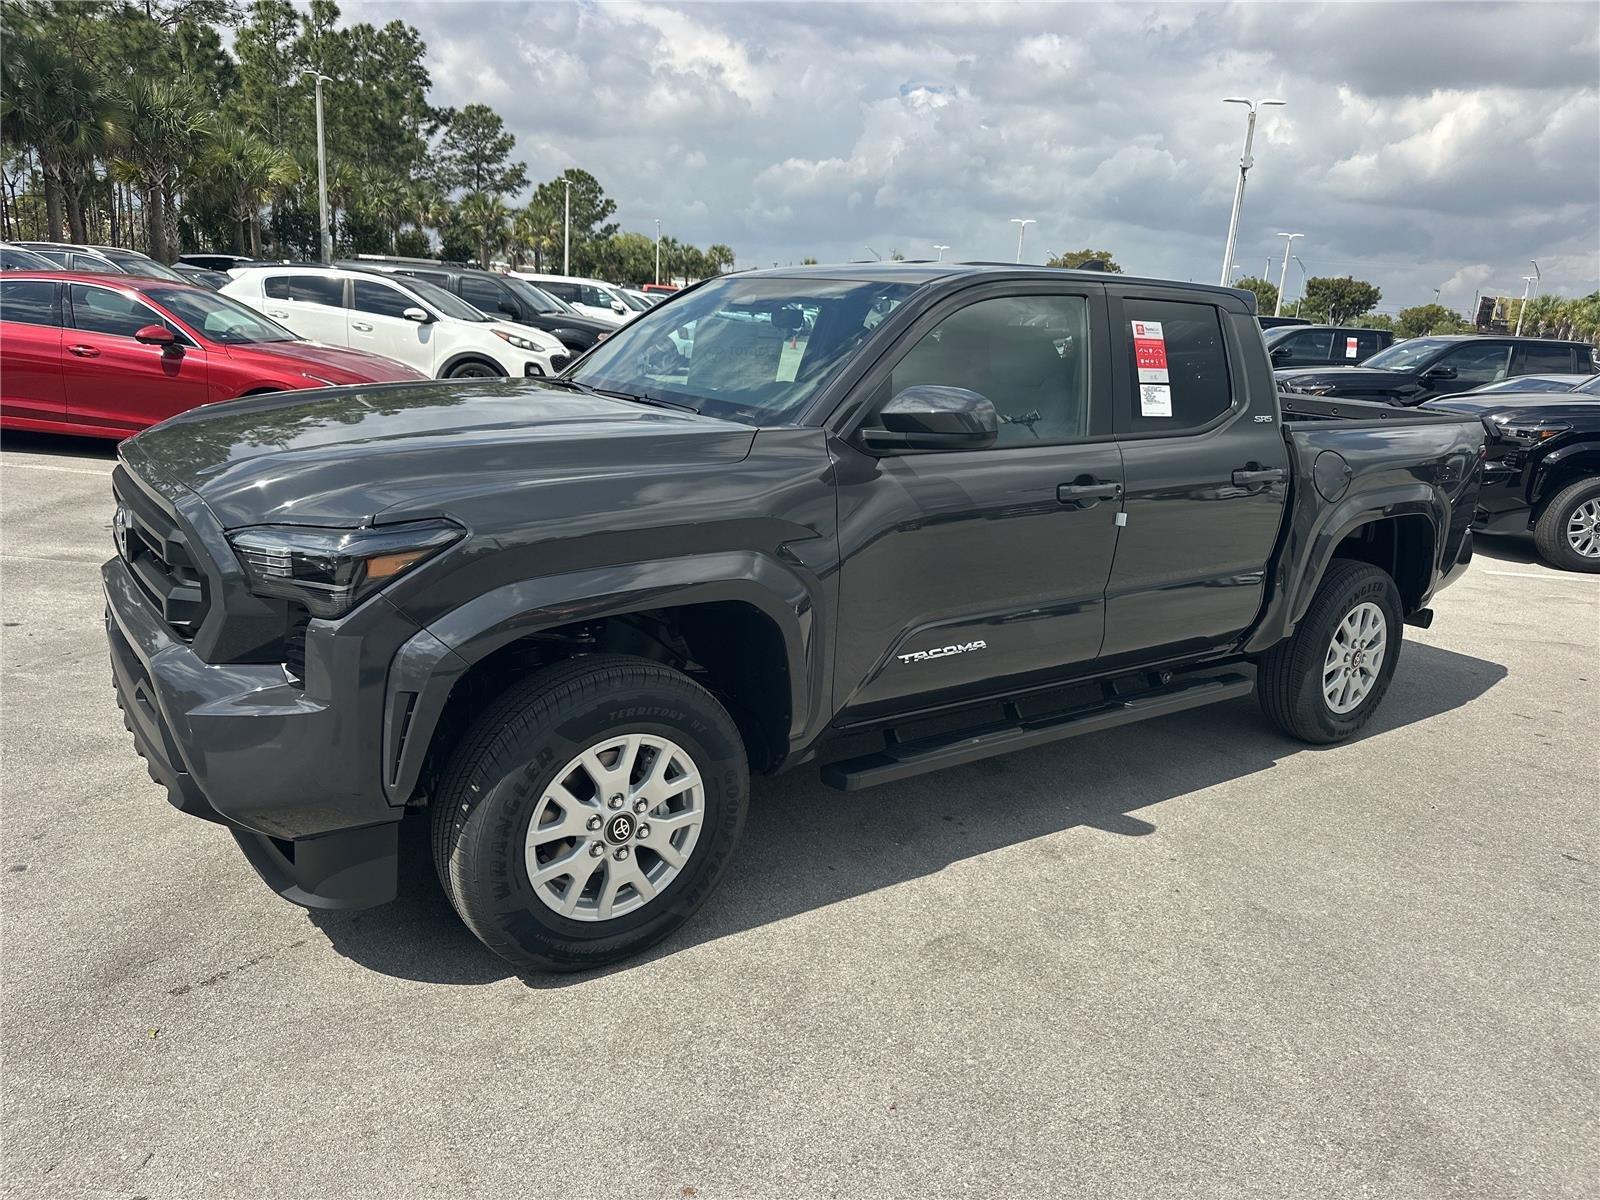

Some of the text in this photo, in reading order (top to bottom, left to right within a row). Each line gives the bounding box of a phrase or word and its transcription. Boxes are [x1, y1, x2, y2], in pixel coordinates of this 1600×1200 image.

[897, 640, 987, 663] TACOMA
[609, 706, 687, 721] TERRITORY
[490, 746, 554, 902] WRANGLER
